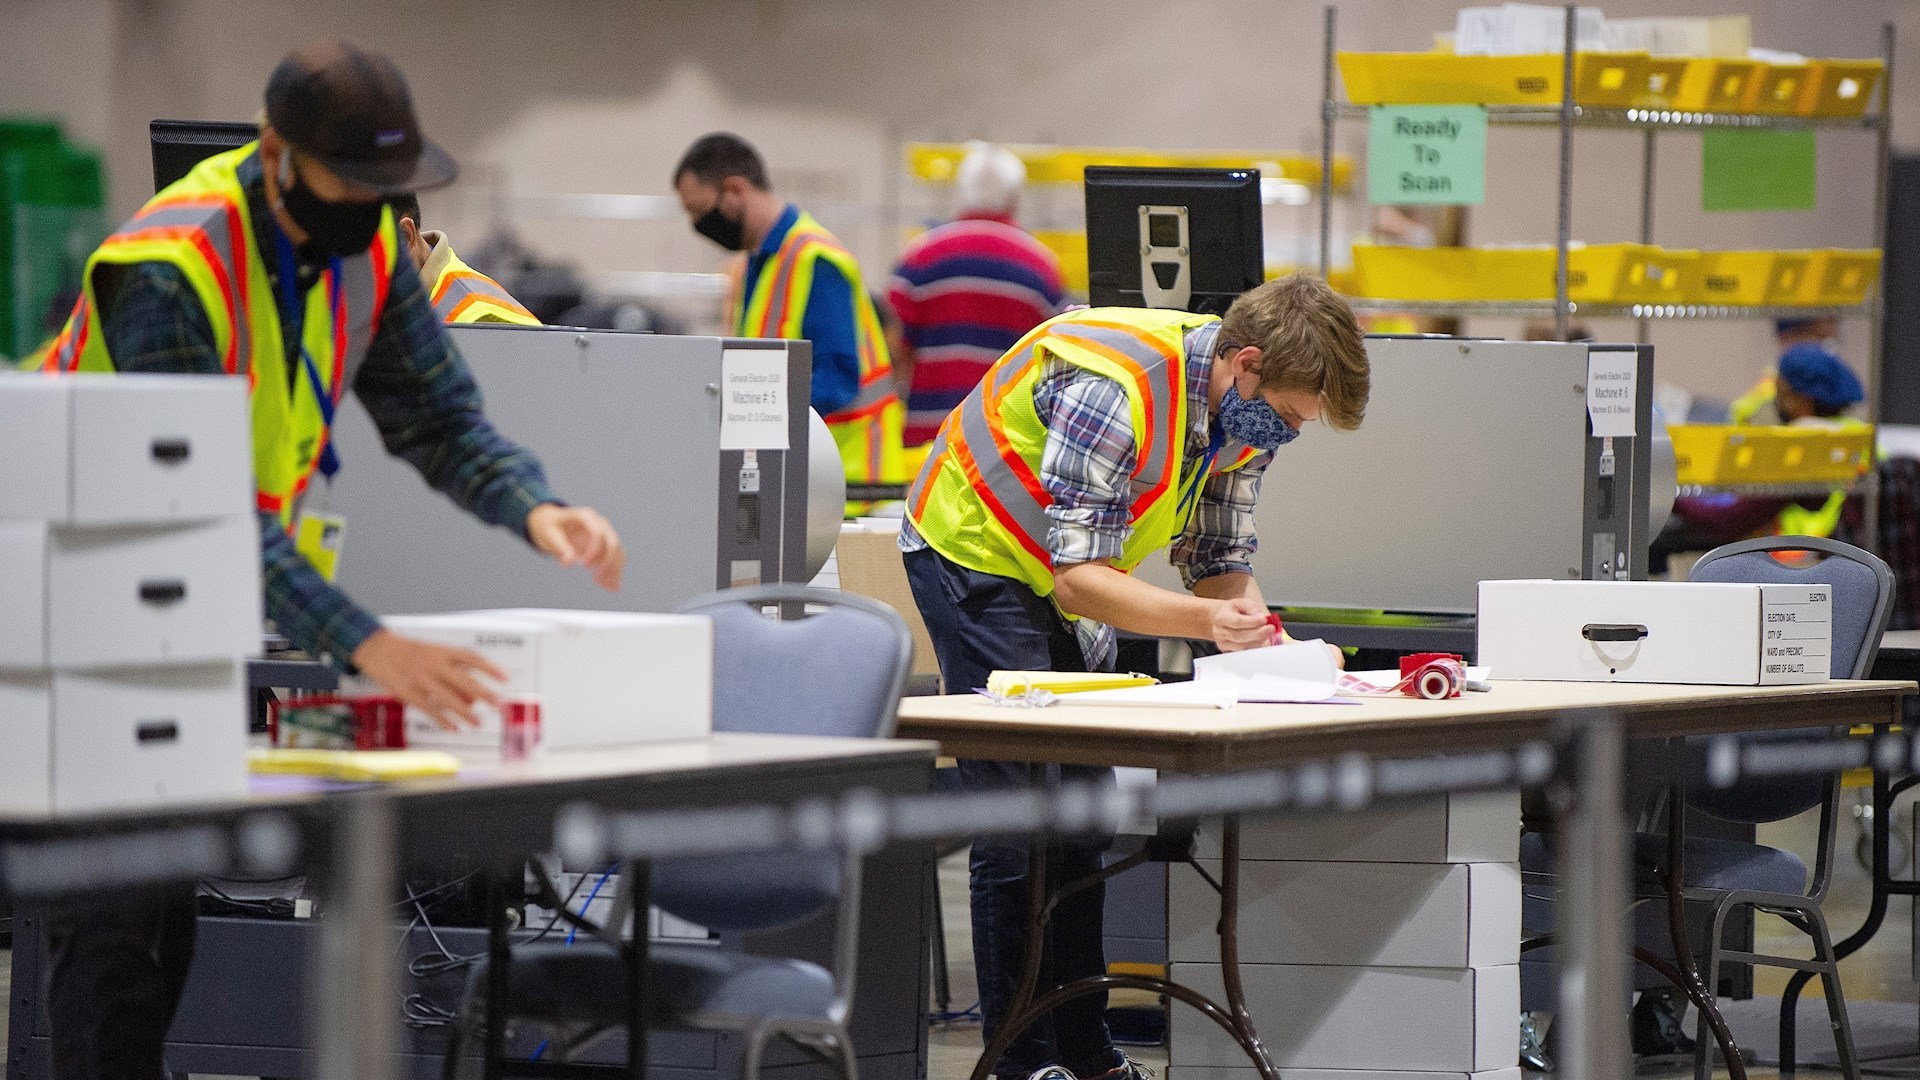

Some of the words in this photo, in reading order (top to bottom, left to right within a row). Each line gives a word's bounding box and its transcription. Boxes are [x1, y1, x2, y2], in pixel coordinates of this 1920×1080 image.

[1395, 116, 1461, 141] Ready
[1413, 144, 1441, 165] To
[1400, 172, 1452, 194] Scan
[749, 373, 767, 382] Election
[1595, 386, 1618, 399] Machine
[1624, 386, 1629, 399] 6
[733, 391, 761, 404] Machine
[771, 391, 776, 404] 5
[1809, 593, 1827, 602] ELECTION
[1768, 613, 1785, 622] ELECTION
[1786, 613, 1796, 622] DATE
[1768, 630, 1776, 639] CITY
[1777, 630, 1782, 639] OF
[1767, 647, 1778, 656] WARD
[1786, 647, 1804, 656] PRECINCT
[1766, 664, 1781, 673] NUMBER
[1782, 664, 1787, 673] OF
[1788, 664, 1804, 673] BALLOTS
